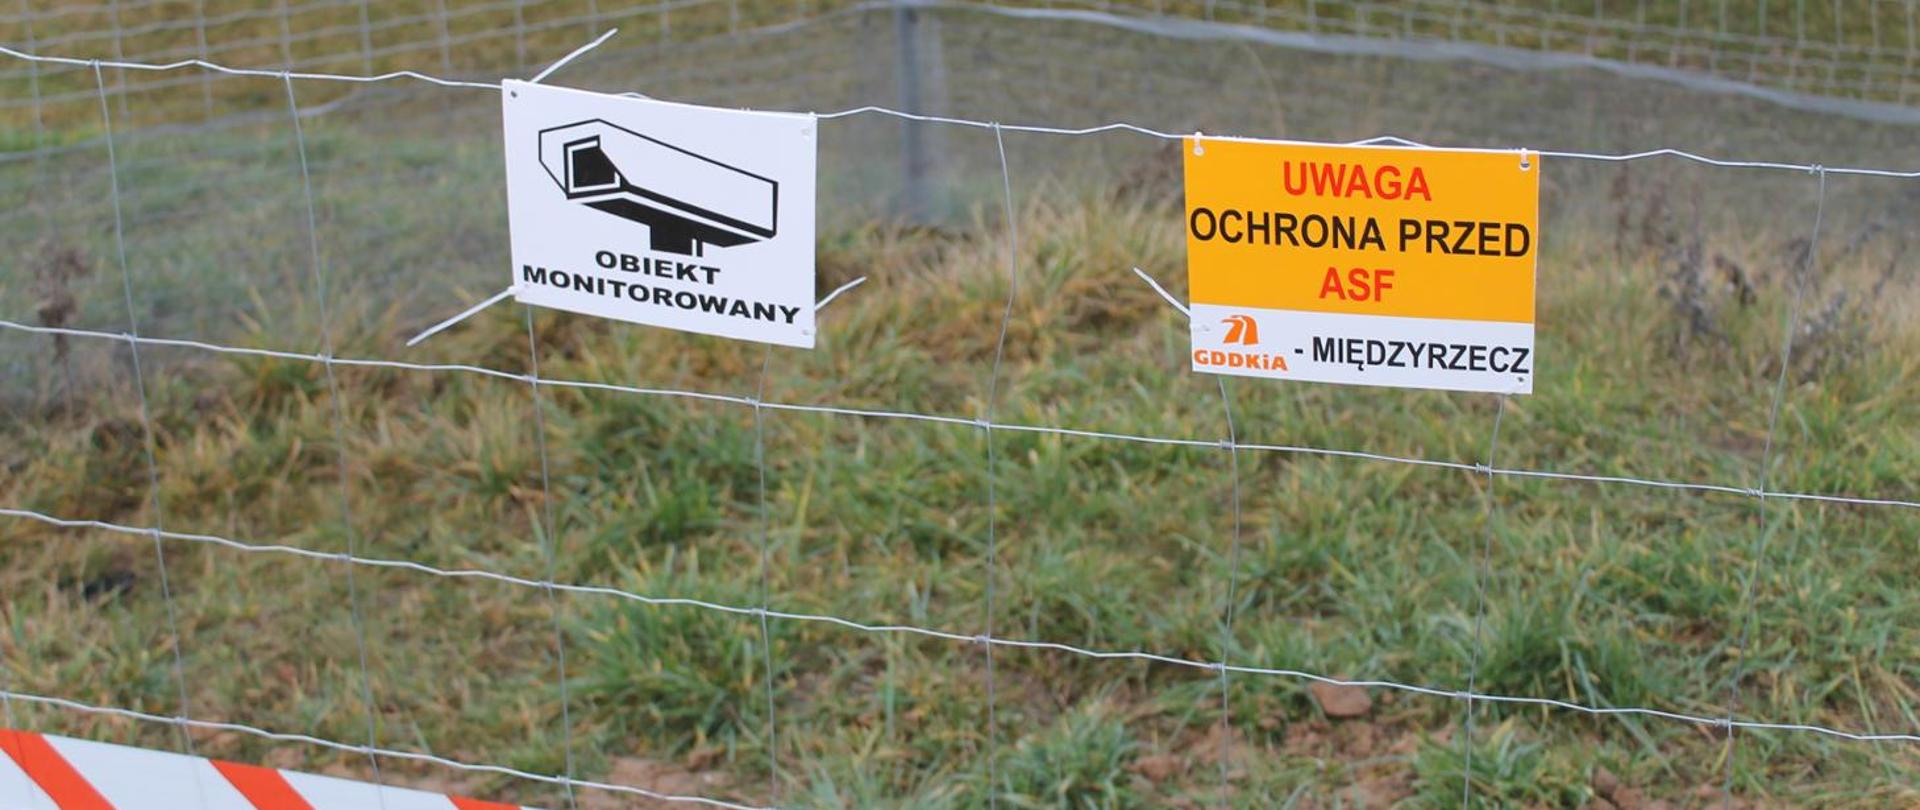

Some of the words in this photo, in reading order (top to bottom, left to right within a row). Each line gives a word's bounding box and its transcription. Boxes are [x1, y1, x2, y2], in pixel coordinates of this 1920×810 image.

[1282, 161, 1432, 202] UWAGA
[1190, 207, 1386, 252] OCHRONA
[1399, 218, 1531, 257] PRZED
[595, 250, 721, 285] OBIEKT
[1319, 266, 1396, 302] ASF
[523, 265, 800, 324] MONITOROWANY
[1193, 349, 1289, 371] GDDKiA
[1312, 336, 1531, 374] MIĘDZYRZECZ
